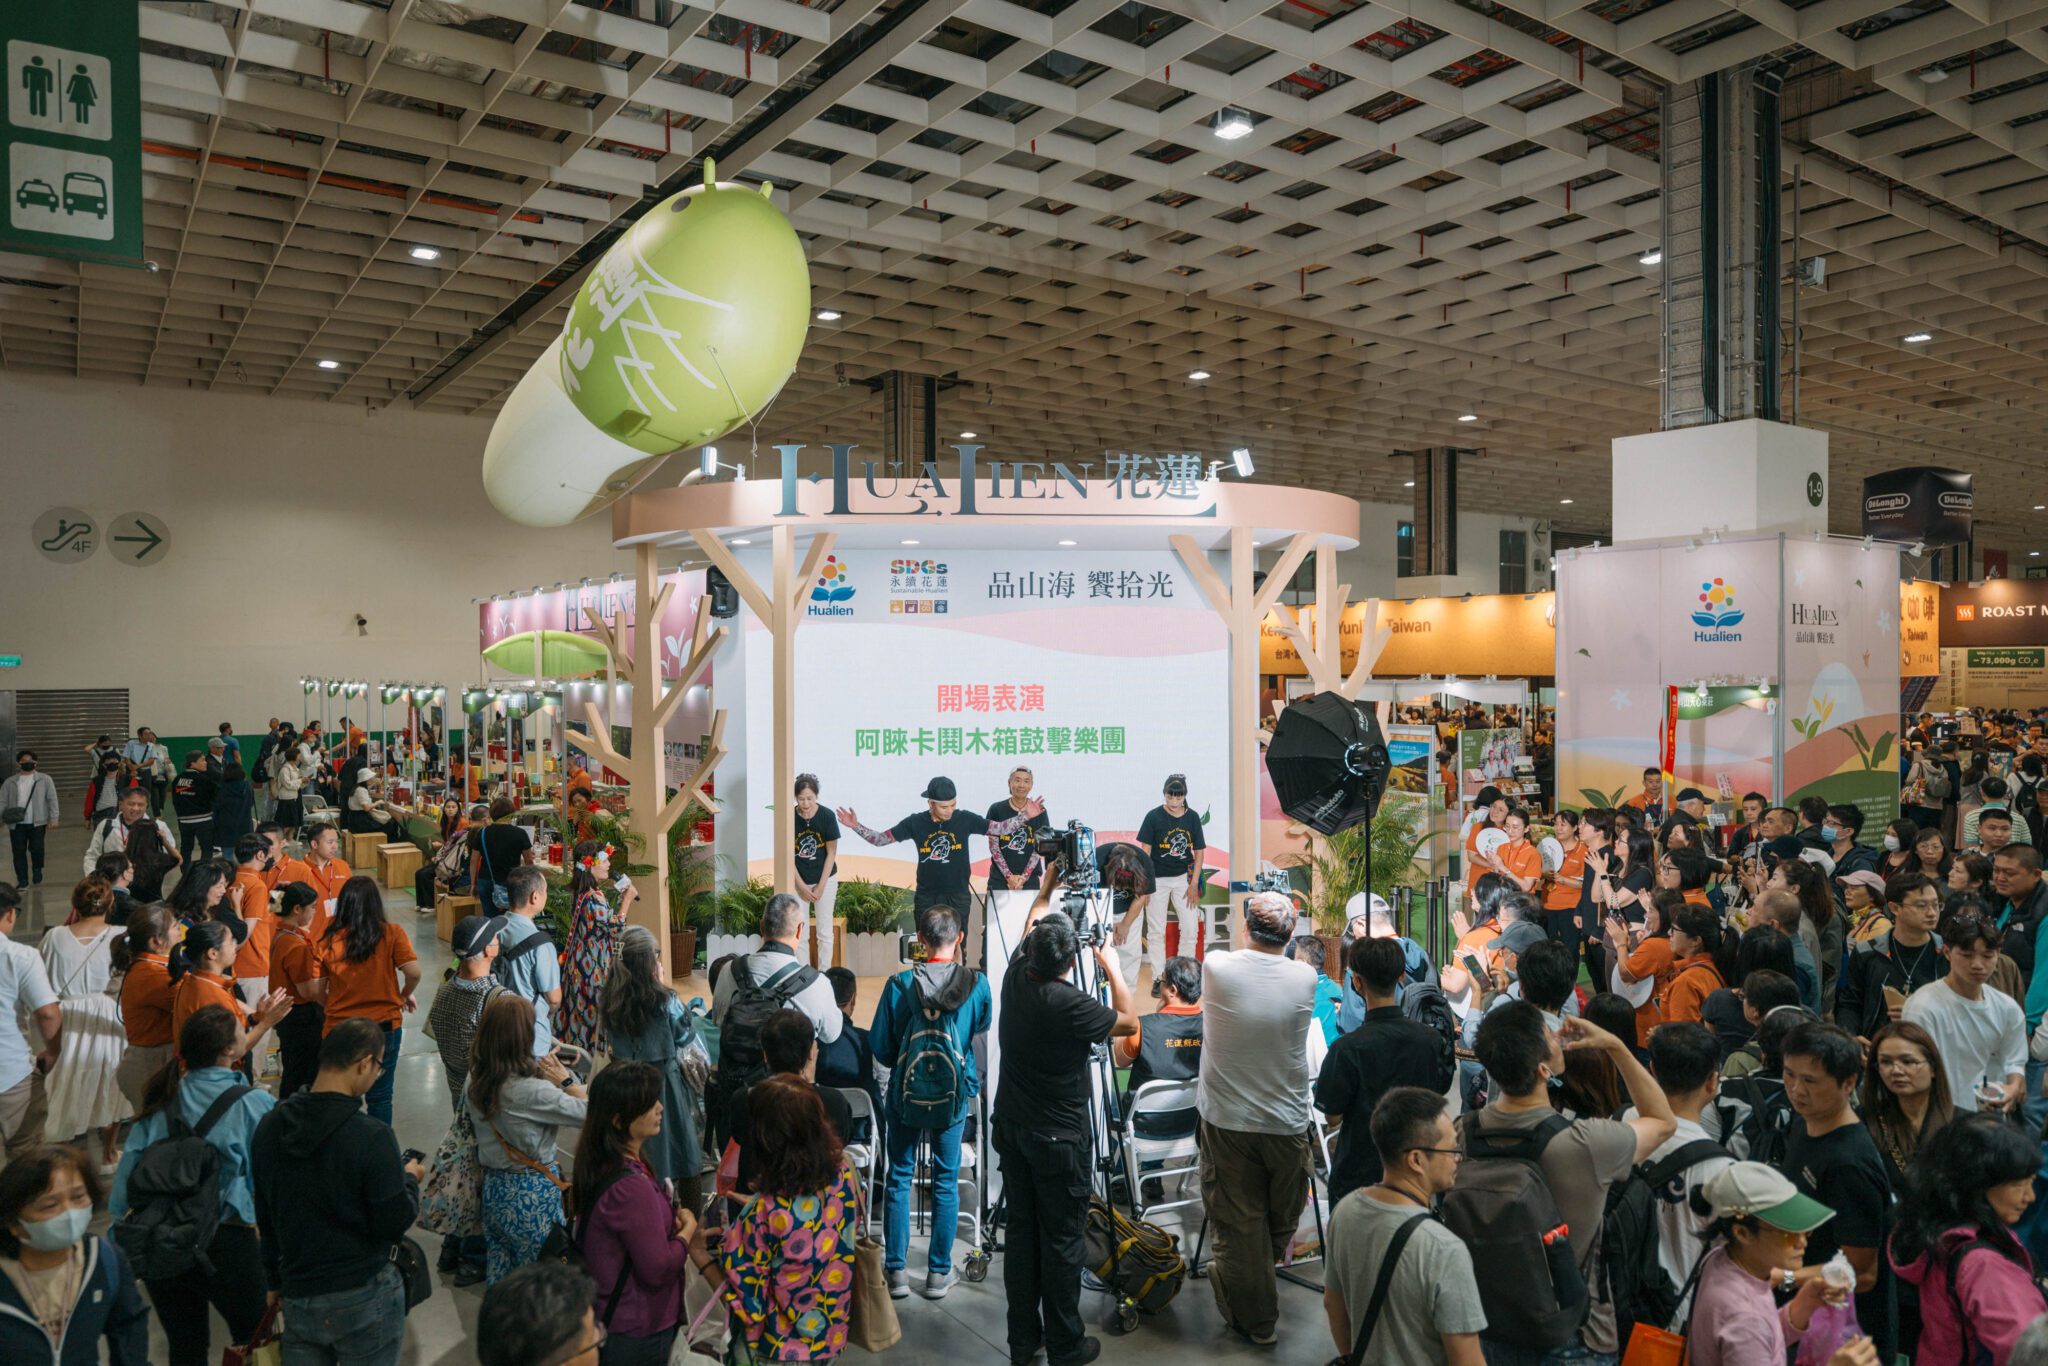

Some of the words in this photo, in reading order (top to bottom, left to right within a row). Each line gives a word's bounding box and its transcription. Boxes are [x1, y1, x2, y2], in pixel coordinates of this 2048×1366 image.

[1107, 453, 1200, 500] 花蓮
[1808, 481, 1823, 497] 1-9
[72, 541, 91, 553] 4F
[890, 560, 948, 574] SDGs
[988, 571, 1075, 599] 品山海
[1088, 570, 1174, 599] 饗拾光
[808, 605, 854, 616] Hualien
[1982, 605, 2037, 617] ROAST
[1386, 618, 1432, 634] Taiwan
[1694, 631, 1742, 642] Hualien
[1907, 628, 1928, 640] Taiwan
[937, 684, 1045, 713] 開場表演
